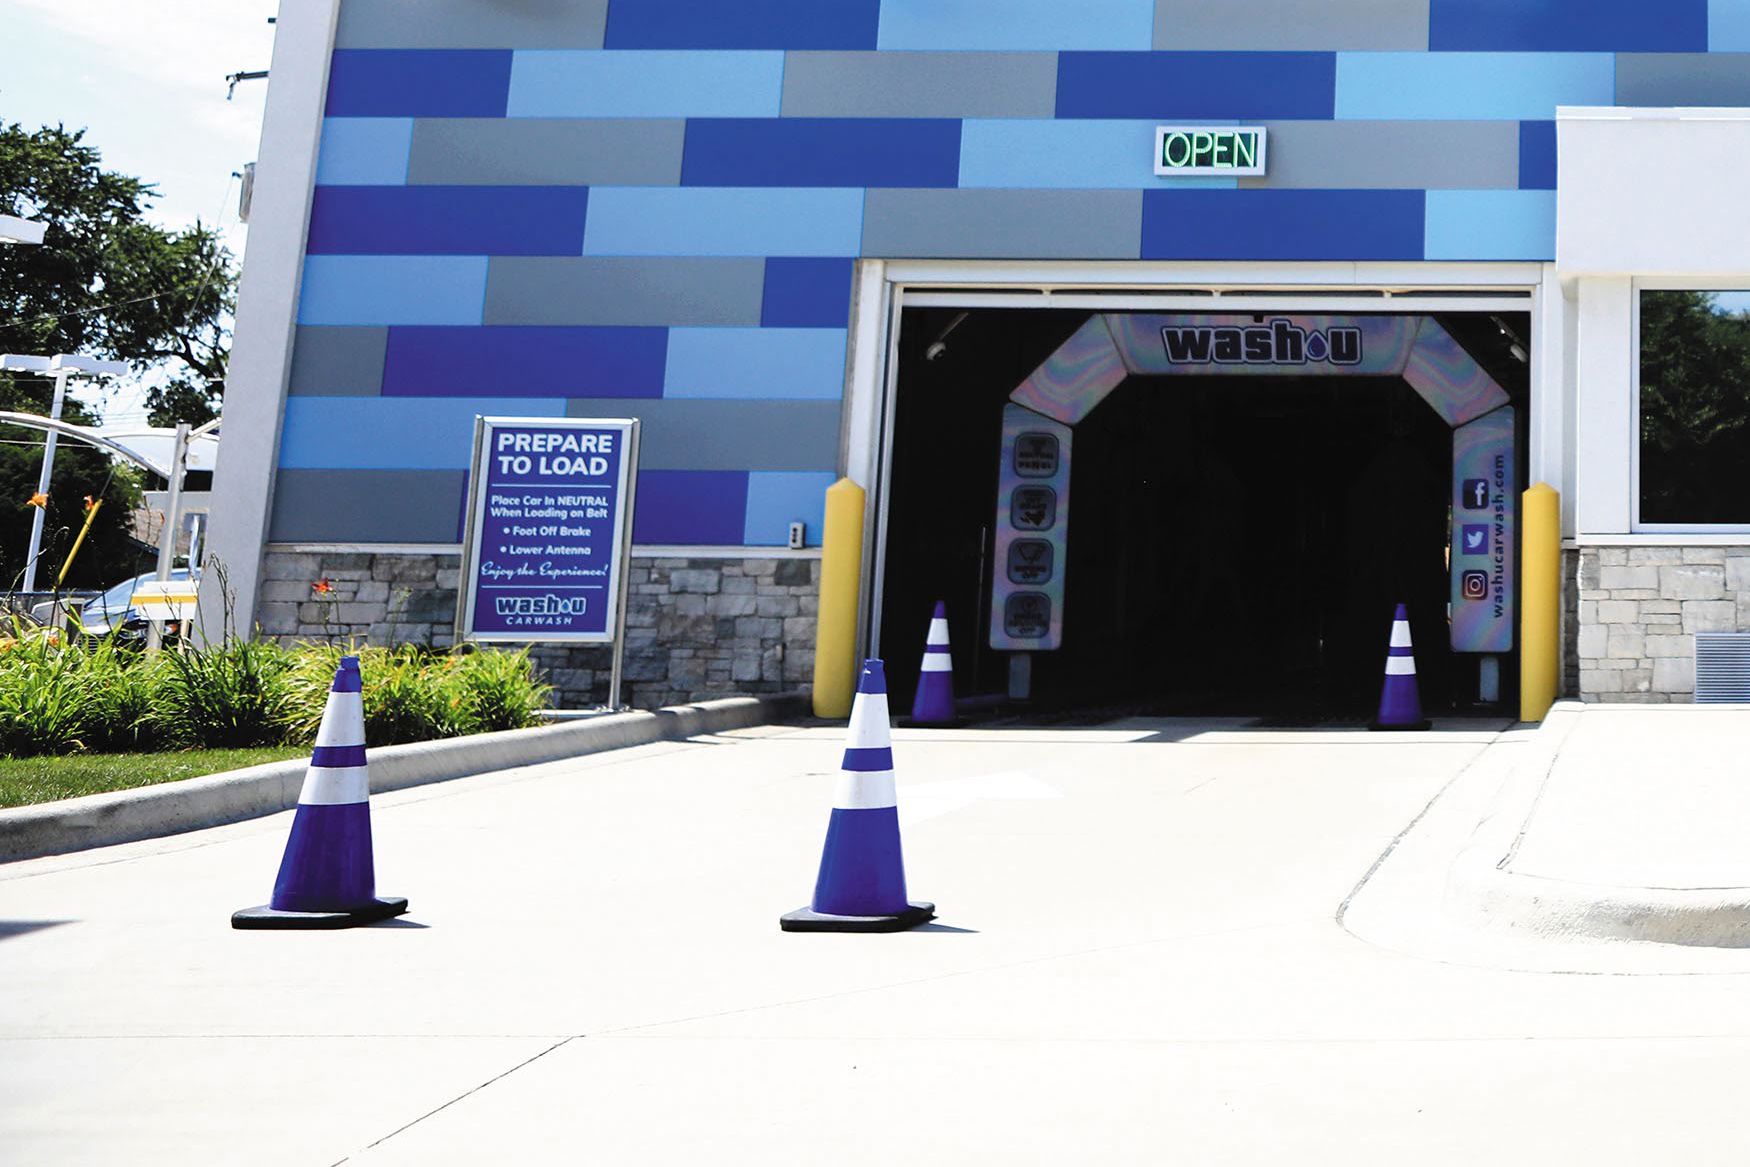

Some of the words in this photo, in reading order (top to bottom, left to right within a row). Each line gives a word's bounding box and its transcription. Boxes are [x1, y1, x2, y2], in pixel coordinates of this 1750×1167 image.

[1164, 132, 1256, 168] OPEN
[498, 433, 613, 453] PREPARE
[498, 456, 532, 475] TO
[539, 457, 608, 476] LOAD
[491, 495, 520, 506] Place
[523, 496, 542, 505] Car
[557, 496, 608, 506] NEUTRAL
[491, 507, 521, 517] When
[525, 508, 567, 520] Loading
[570, 509, 584, 517] on
[587, 508, 608, 518] Belt
[513, 526, 537, 536] Foot
[540, 526, 557, 536] Off
[560, 527, 591, 536] Brake
[1491, 455, 1504, 618] washucarwash.com
[509, 545, 543, 554] Lower
[545, 546, 591, 555] Antenna
[481, 561, 515, 580] Enjoy
[506, 617, 572, 625] CARWASH
